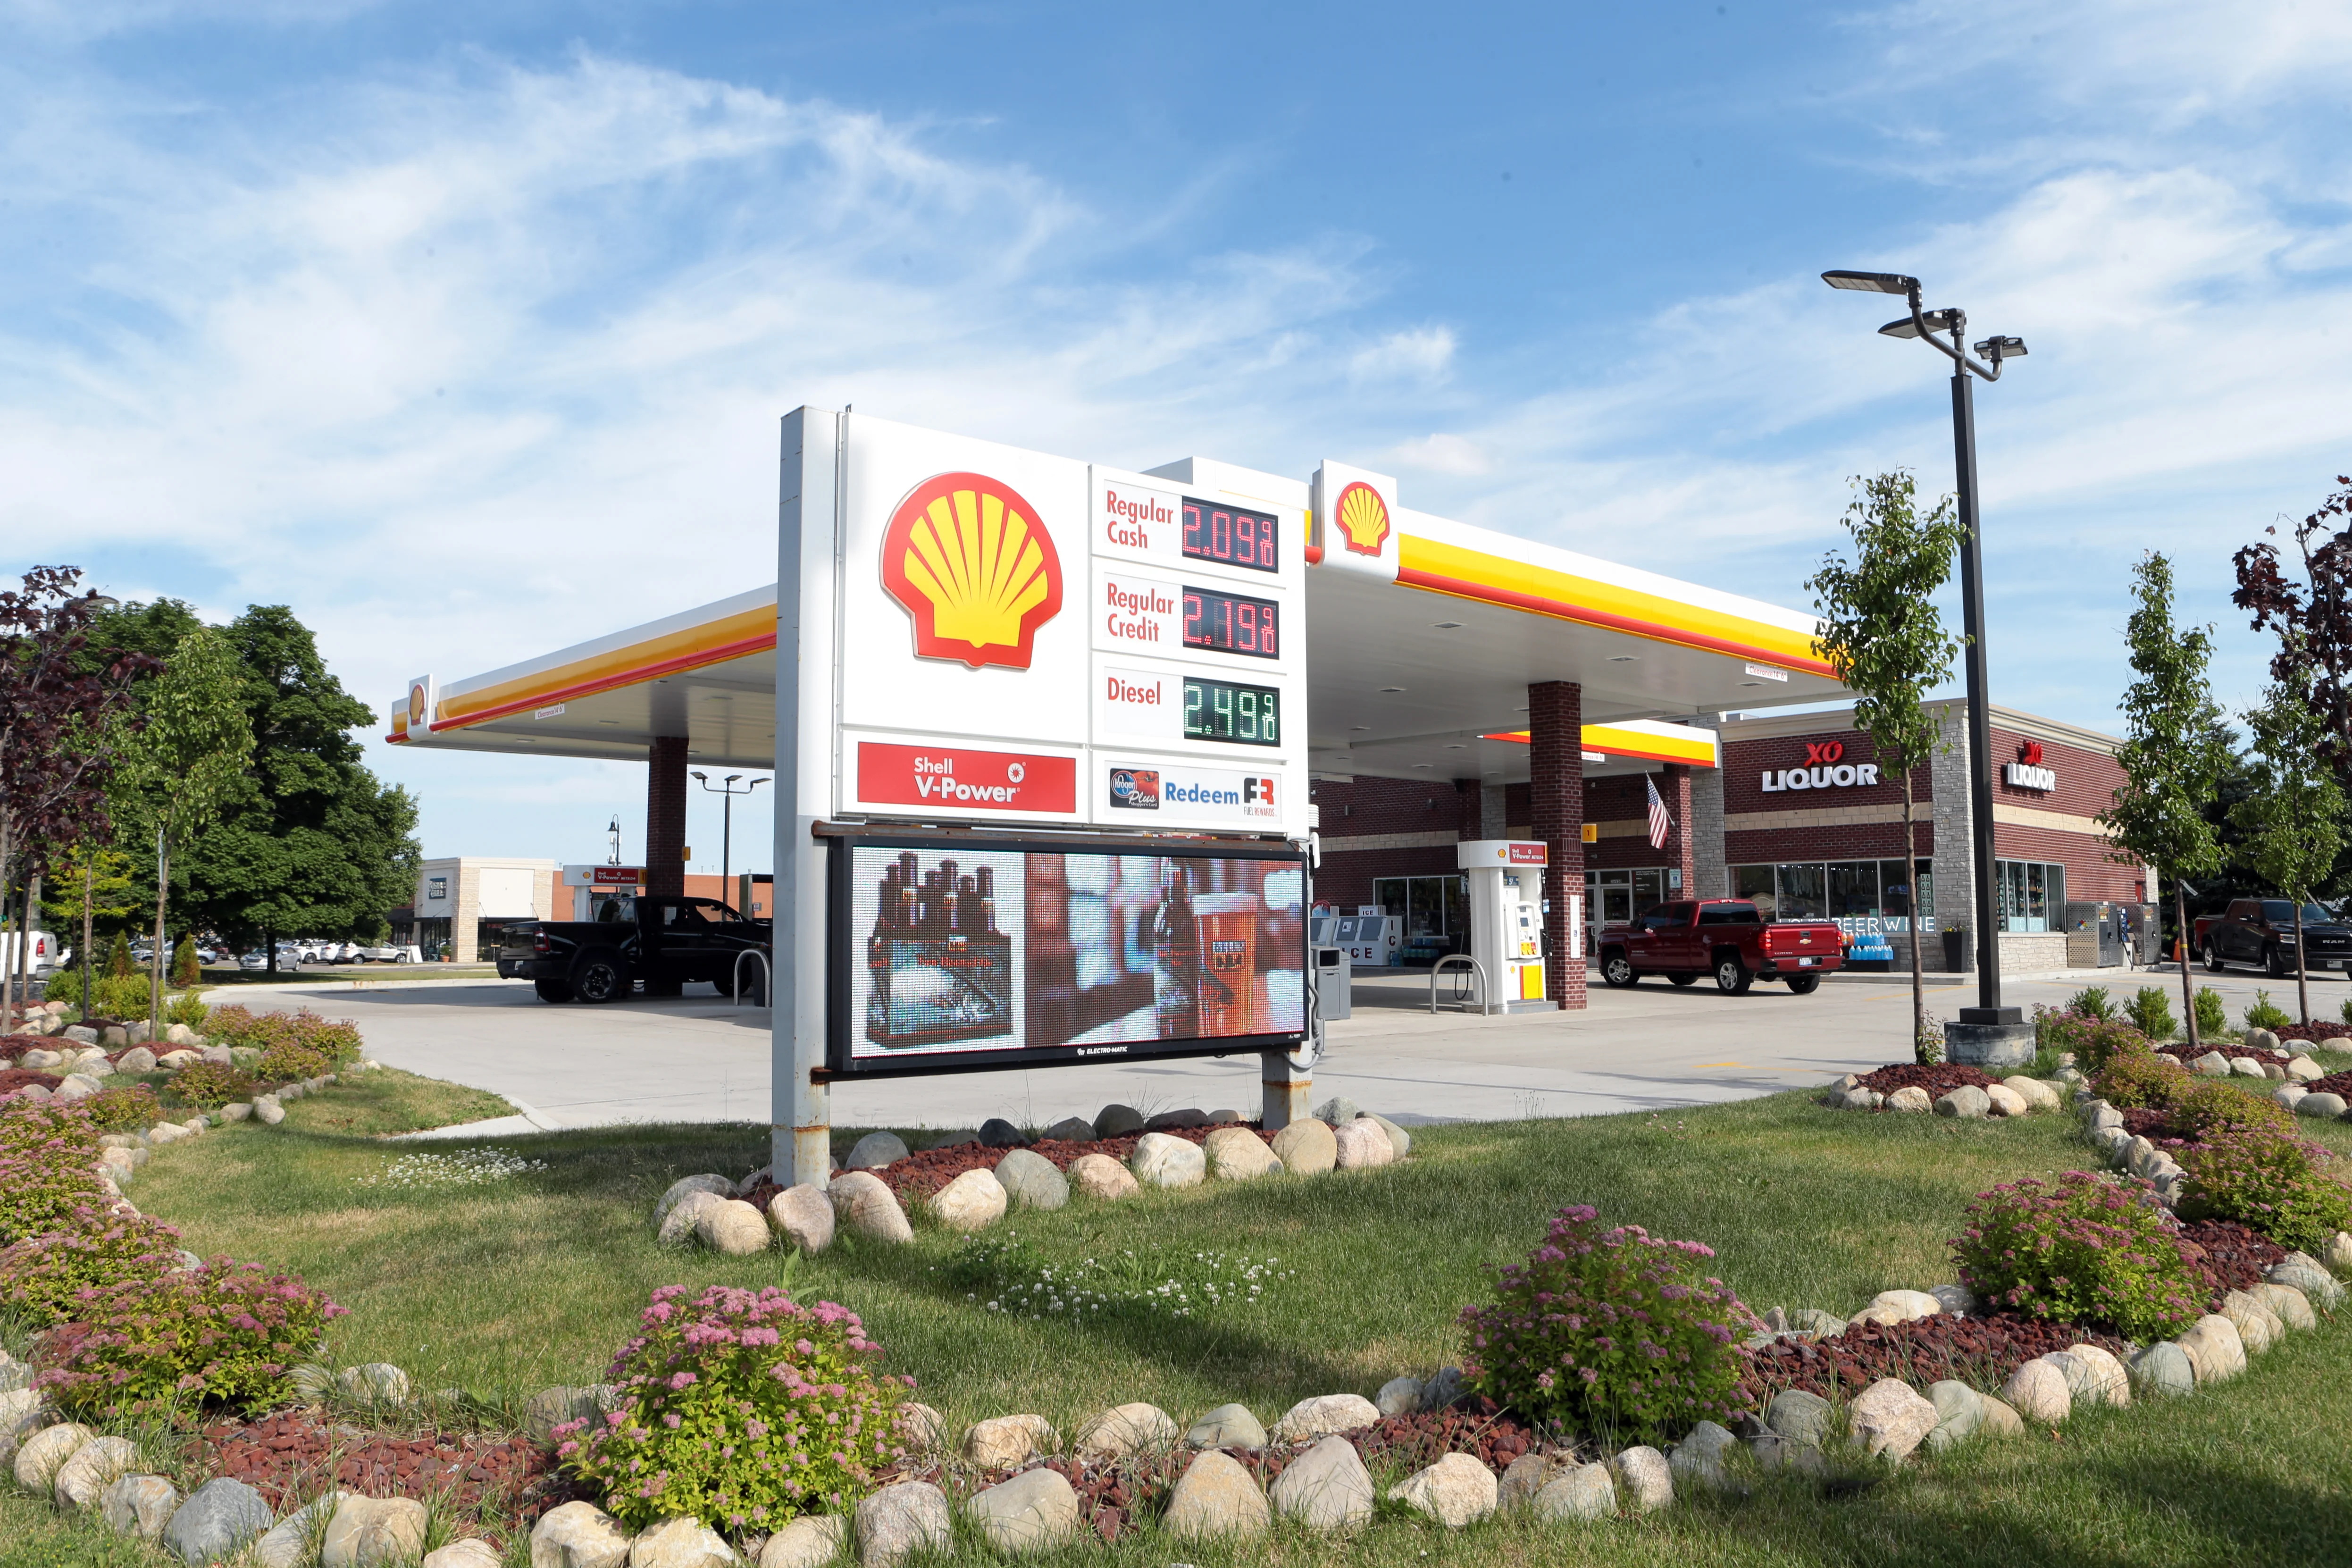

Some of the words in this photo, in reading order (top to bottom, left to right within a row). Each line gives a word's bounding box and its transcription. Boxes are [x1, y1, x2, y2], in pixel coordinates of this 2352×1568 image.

[1107, 490, 1173, 524] Regular
[1183, 505, 1255, 563] 2.09
[1107, 520, 1148, 549] Cash
[1107, 582, 1174, 615] Regular
[1183, 594, 1256, 651] 2.19
[1107, 613, 1159, 642] Credit
[1749, 665, 1773, 677] Clearance
[1108, 677, 1161, 705] Diesel
[1184, 685, 1257, 739] 2.49
[914, 756, 953, 774] Shell
[1804, 740, 1844, 767] XO
[2023, 741, 2042, 765] XO
[914, 775, 1016, 803] V-Power
[1114, 774, 1135, 795] Kroger
[1762, 763, 1878, 792] LIQUOR
[2007, 763, 2056, 791] LIQUOR
[1129, 790, 1156, 805] Plus
[1165, 781, 1239, 805] Redeem
[1244, 806, 1254, 816] FUEL
[1254, 807, 1275, 817] REWARDS
